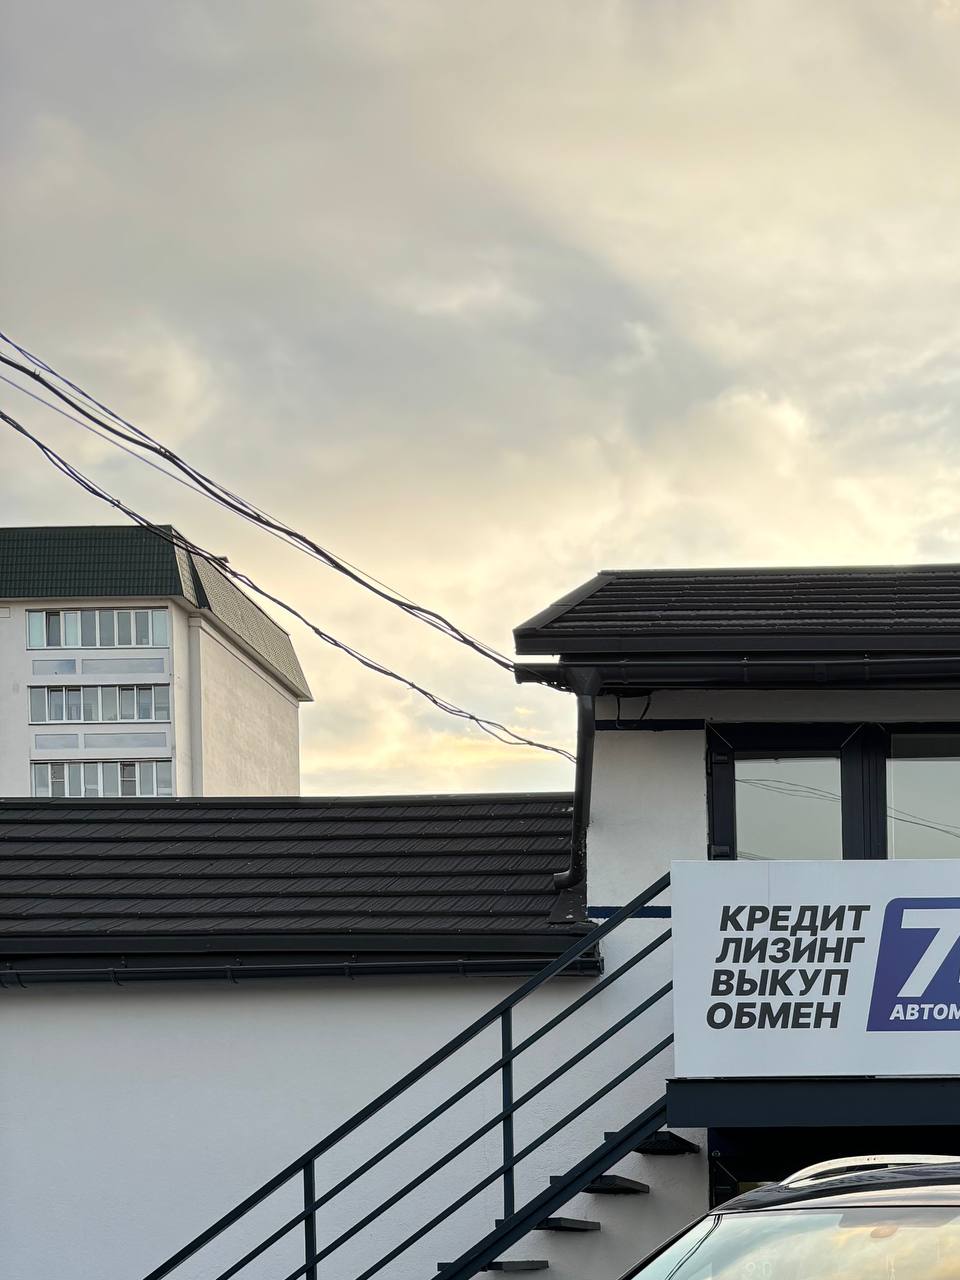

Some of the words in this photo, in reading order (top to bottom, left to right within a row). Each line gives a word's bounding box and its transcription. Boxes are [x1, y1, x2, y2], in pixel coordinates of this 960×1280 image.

[719, 905, 871, 937] КРЕДИТ
[715, 937, 866, 964] ЛИЗИНГ
[710, 968, 849, 997] ВЫКУП
[706, 1001, 841, 1030] ОБМЕН
